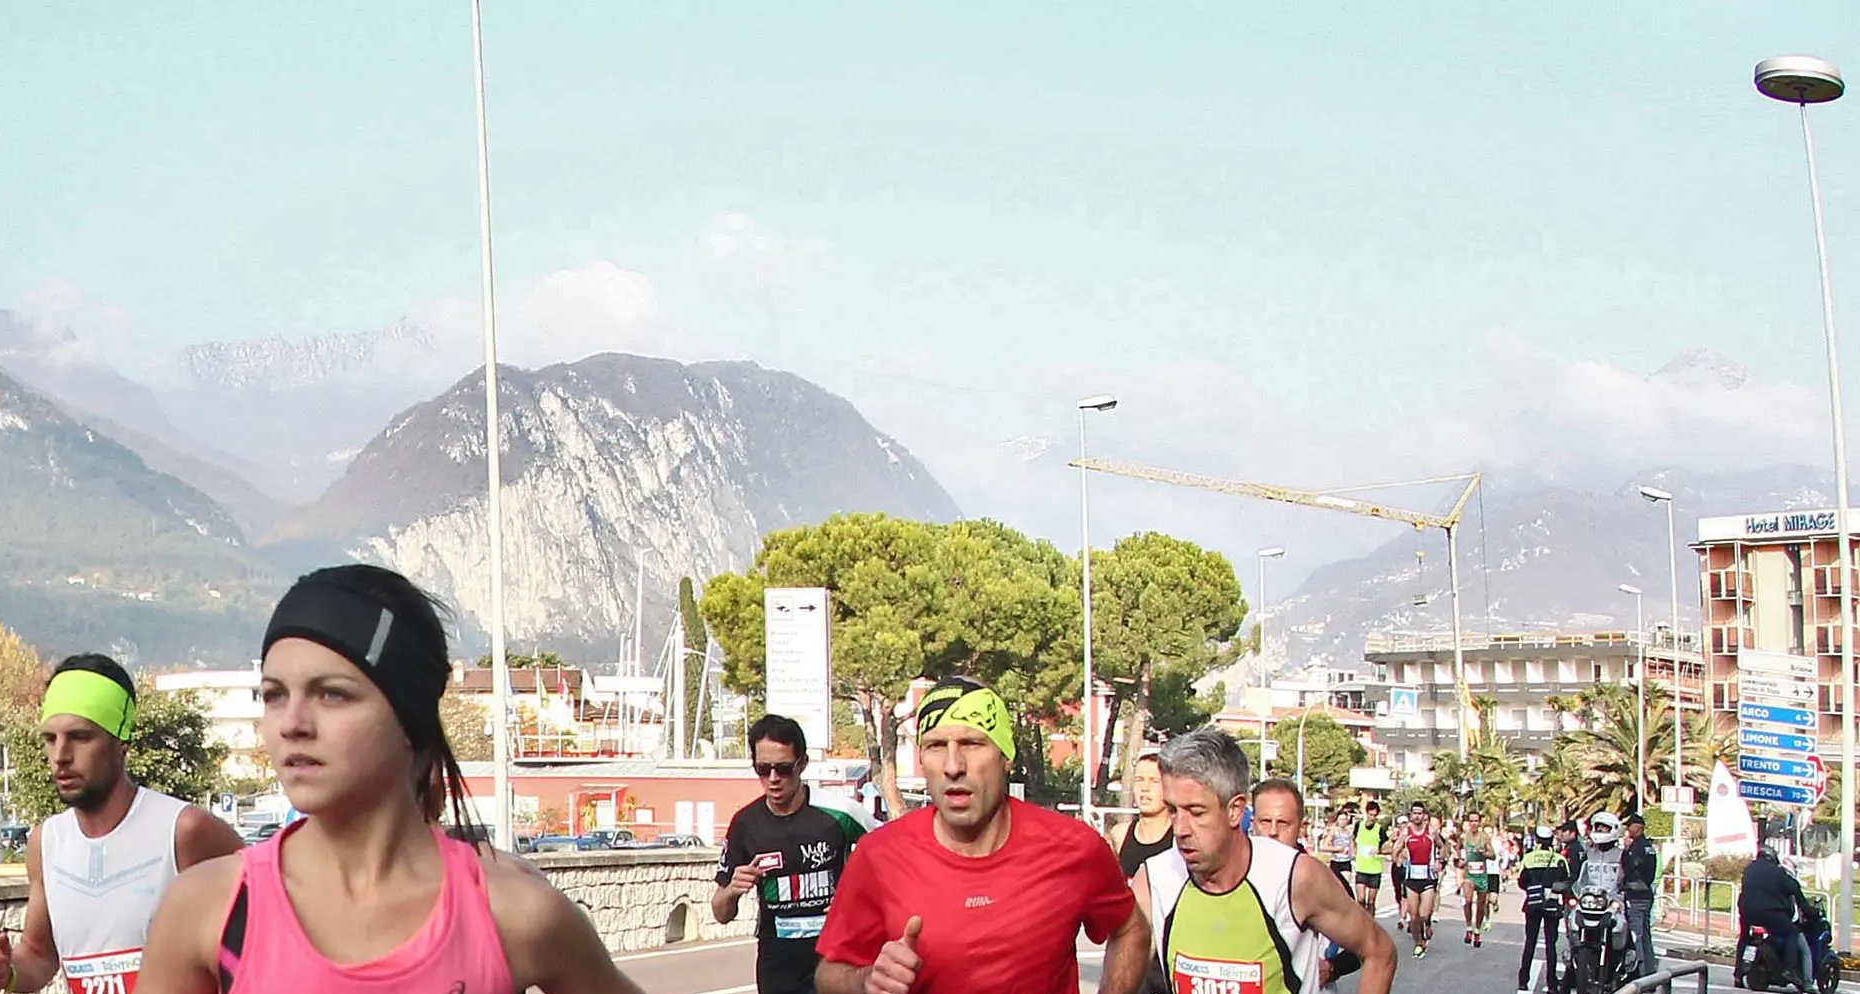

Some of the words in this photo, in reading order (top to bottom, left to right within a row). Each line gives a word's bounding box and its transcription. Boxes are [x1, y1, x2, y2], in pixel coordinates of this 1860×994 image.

[1746, 516, 1779, 534] Hotel
[1783, 512, 1835, 531] MIRAGE
[1742, 707, 1769, 718] ARCO
[1742, 734, 1779, 745] LIMONE
[1742, 759, 1780, 771] TRENTO
[1741, 785, 1783, 797] BRESCIA
